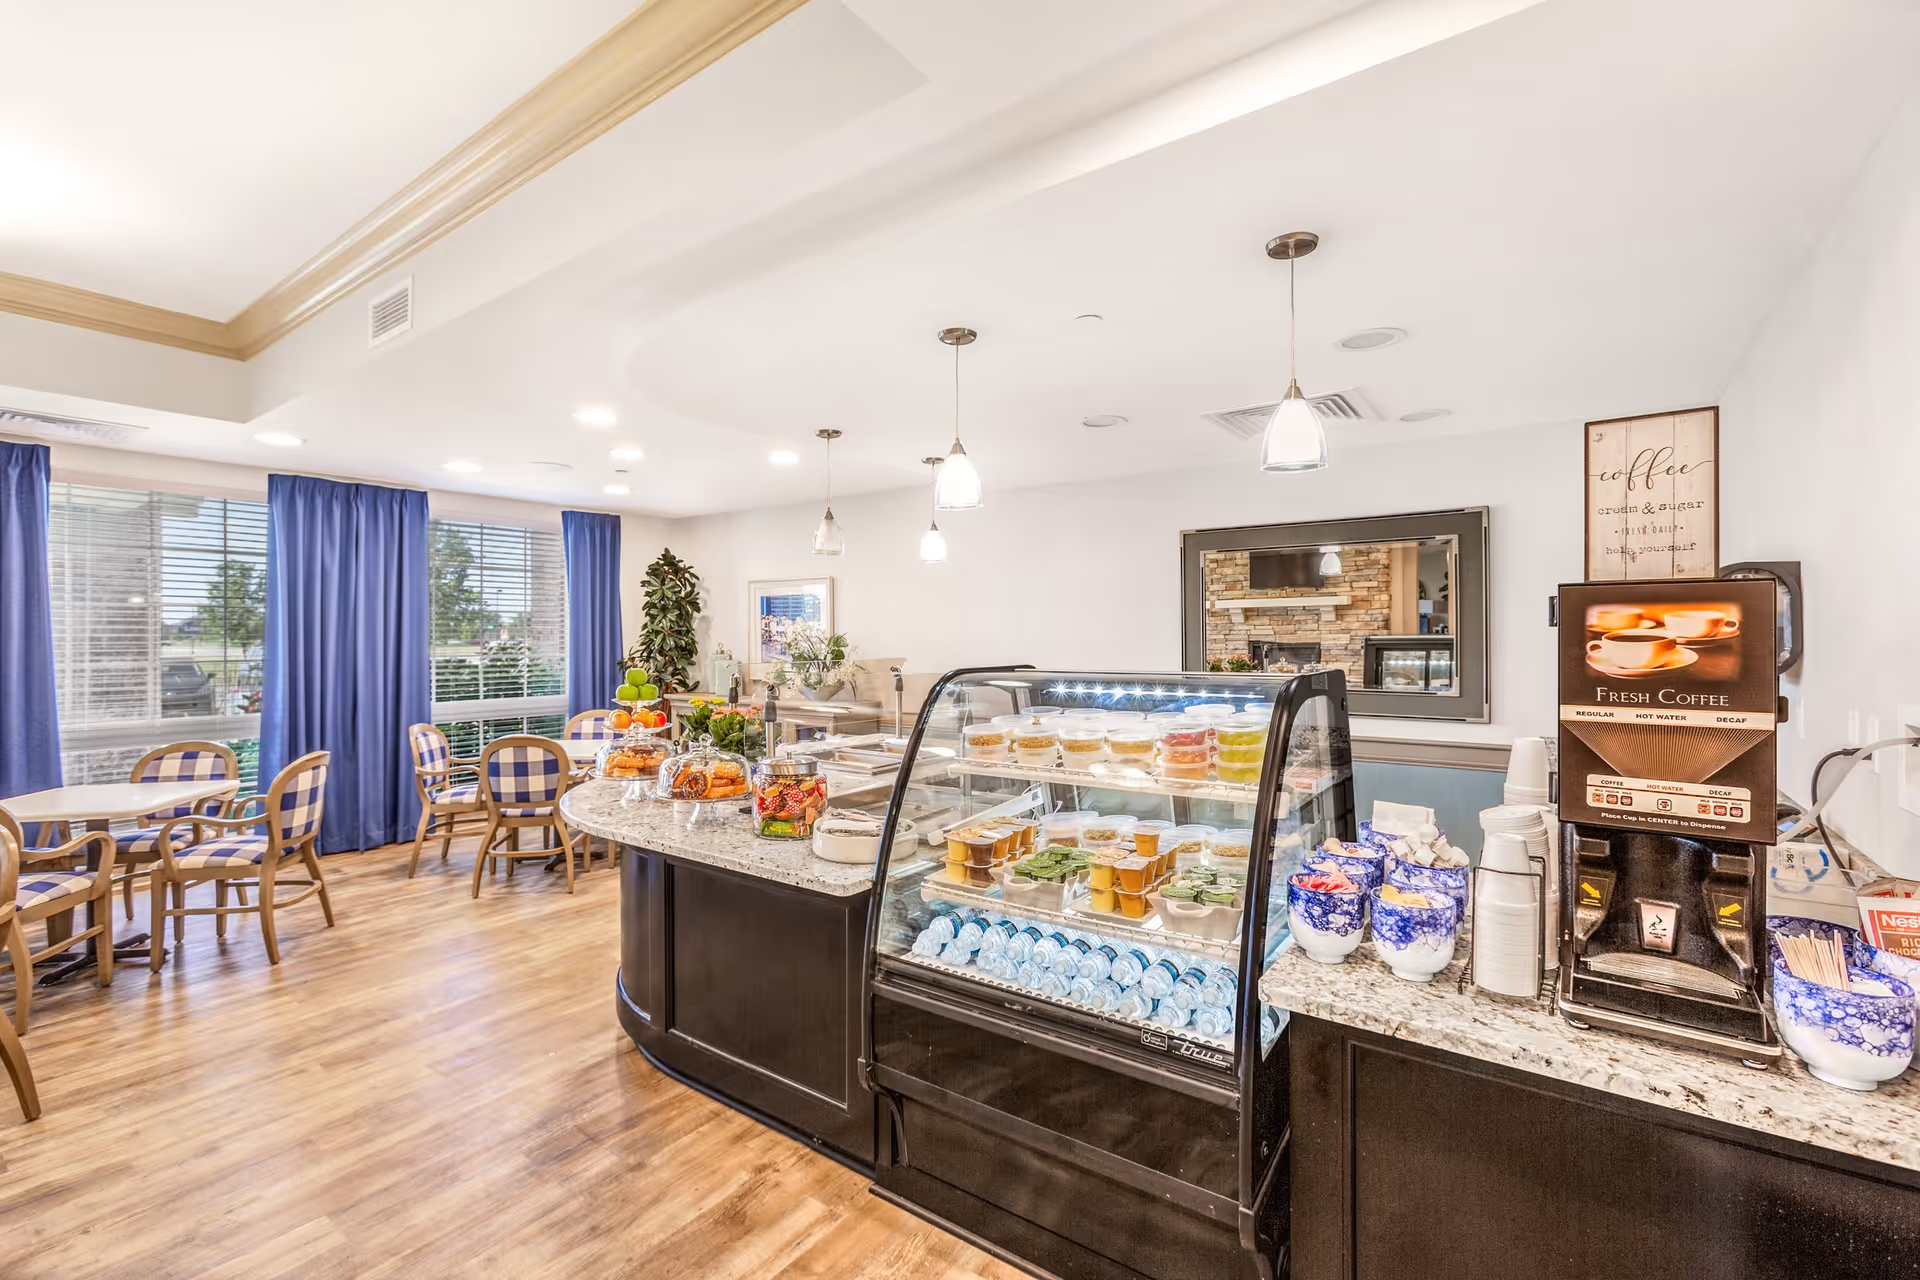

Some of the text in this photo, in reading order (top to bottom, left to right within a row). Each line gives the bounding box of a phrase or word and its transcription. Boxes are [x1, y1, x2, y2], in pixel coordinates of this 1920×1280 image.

[1589, 446, 1712, 491] coffee
[1597, 500, 1704, 515] cream & sugar
[1606, 542, 1696, 555] help yourself
[1575, 710, 1615, 718] REGULAR
[1716, 716, 1748, 724] DECAF
[1600, 779, 1624, 787] COFFEE
[1708, 789, 1732, 797] DECAF
[1600, 812, 1621, 820] Place
[1622, 814, 1637, 822] Cup
[1647, 817, 1679, 825] CENTER
[1690, 821, 1727, 830] Dispense
